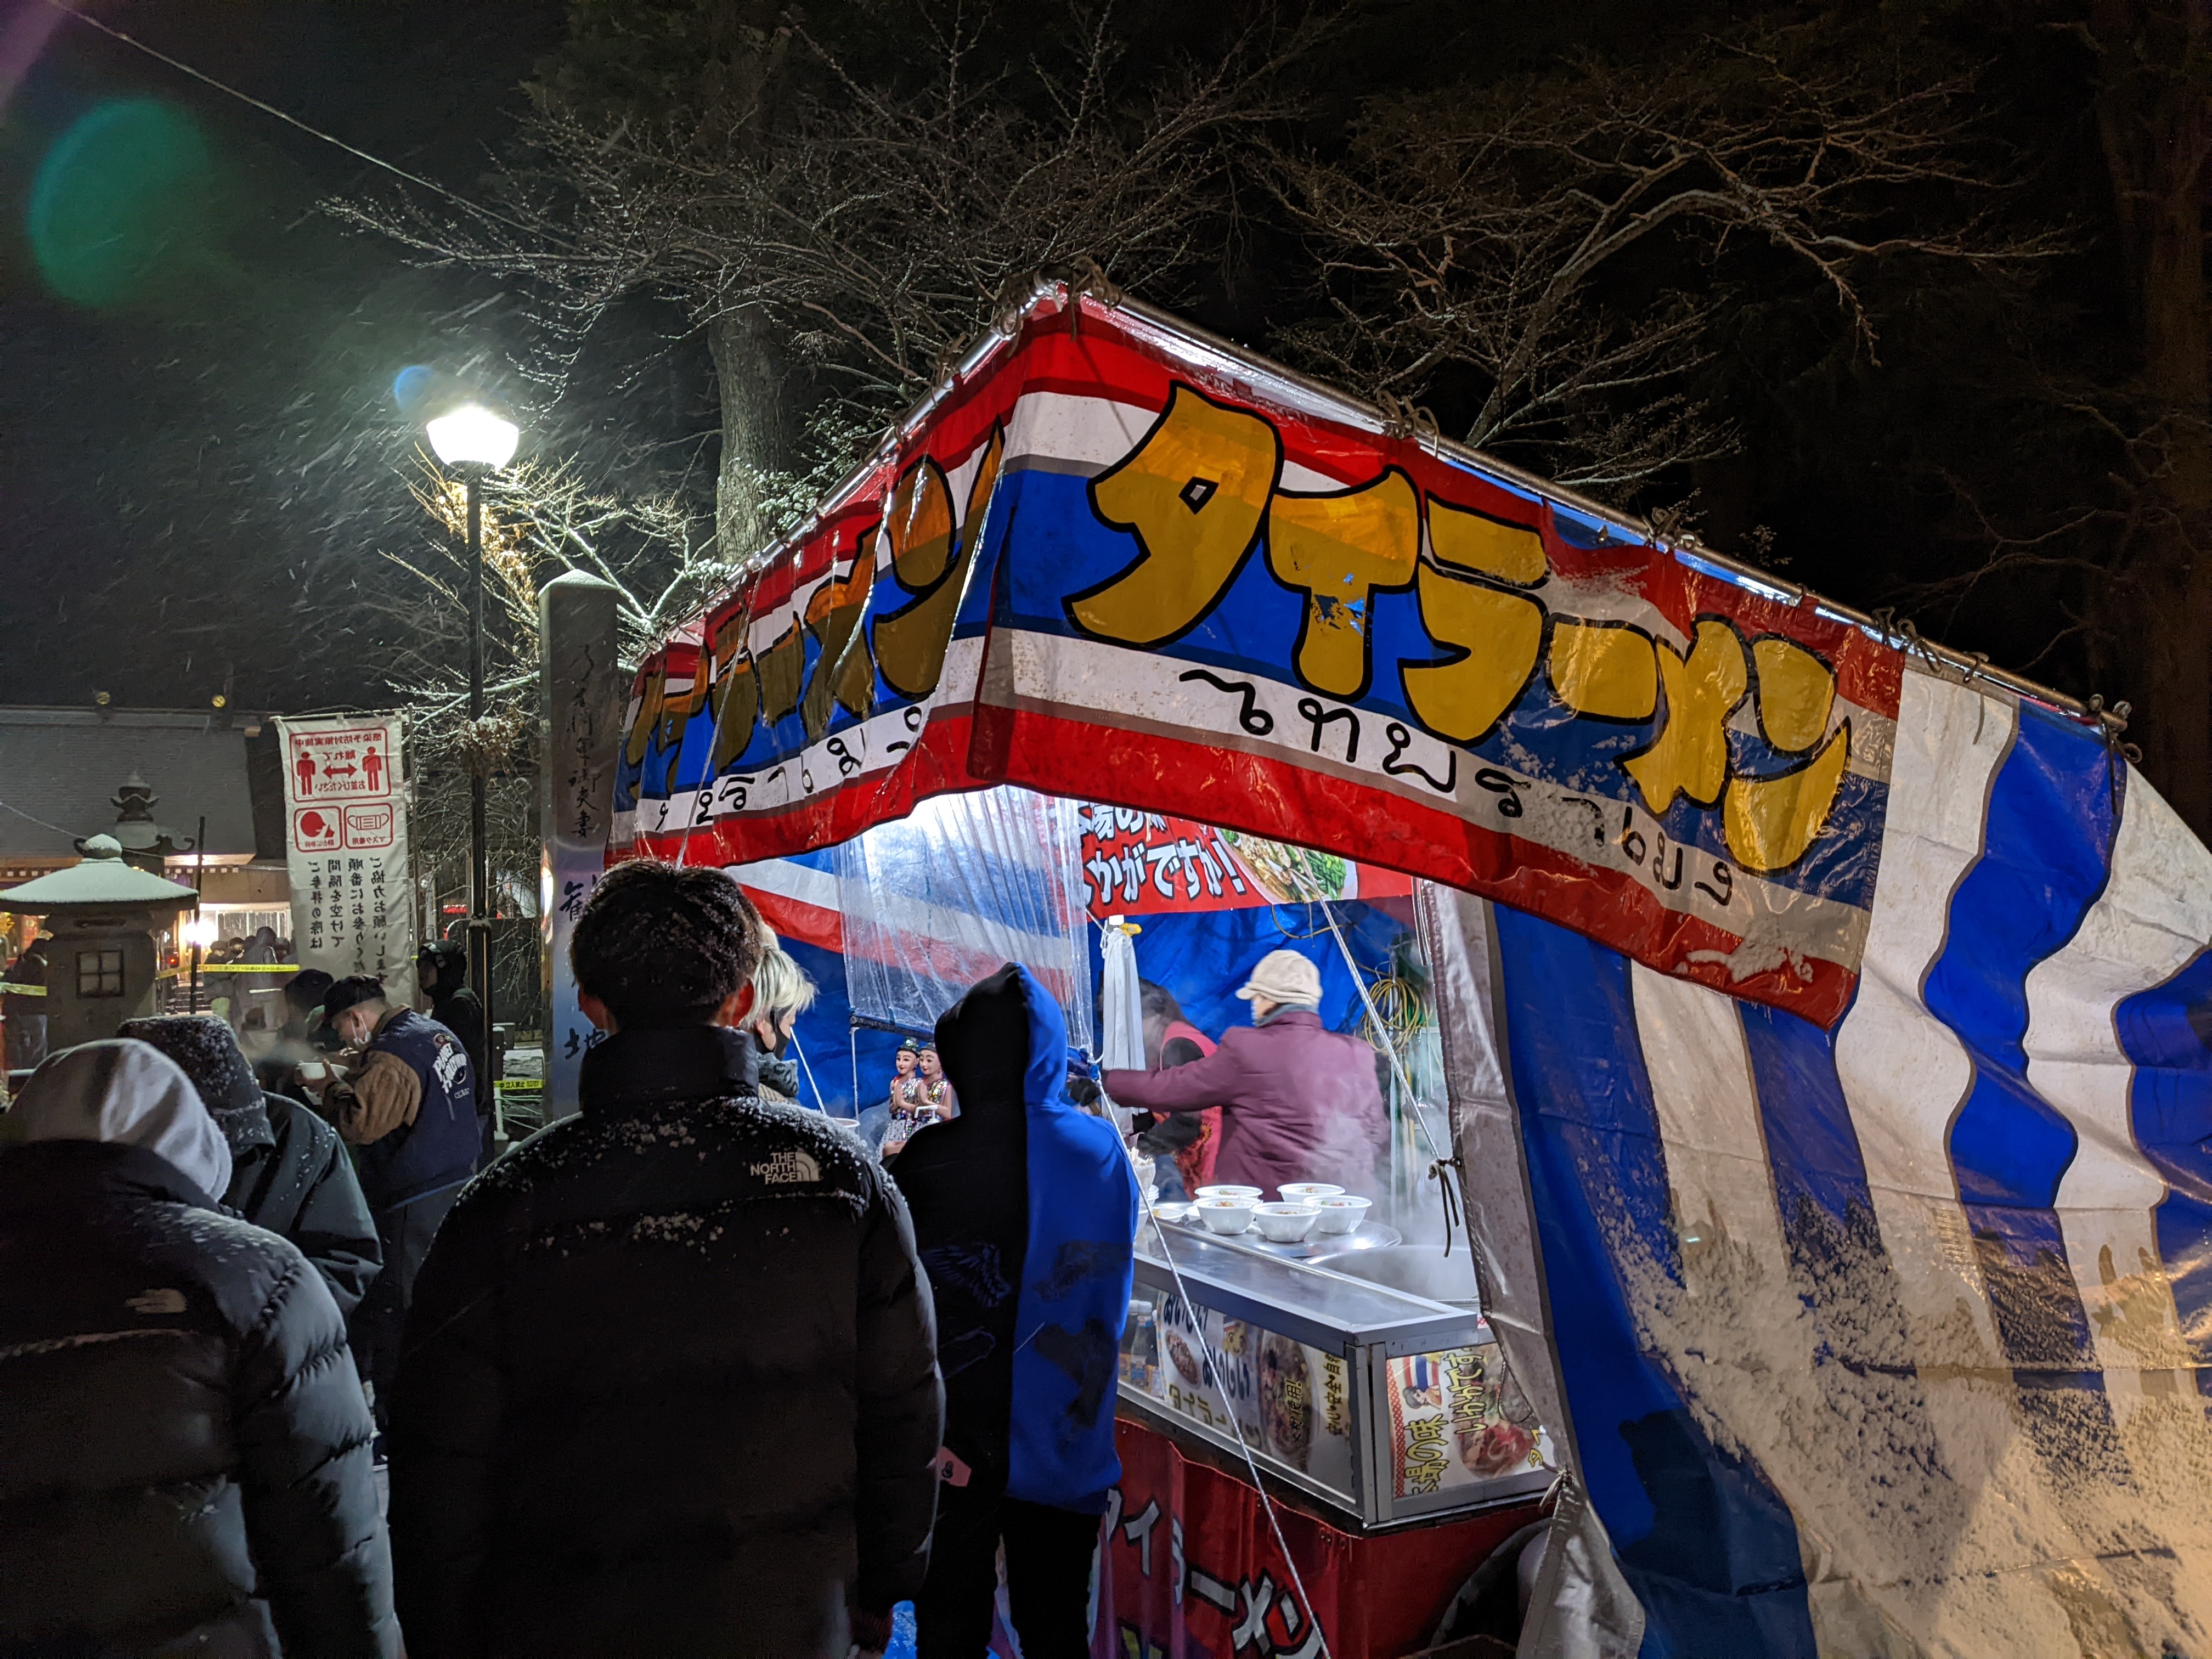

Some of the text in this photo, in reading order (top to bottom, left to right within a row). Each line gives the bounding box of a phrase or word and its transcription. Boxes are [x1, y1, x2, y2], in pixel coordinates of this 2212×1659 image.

[1061, 380, 1852, 878] タイラーメン
[770, 1152, 795, 1164] THE
[750, 1161, 795, 1176] NORTH
[765, 1172, 797, 1185] FACE
[1444, 1346, 1488, 1434] いかがです
